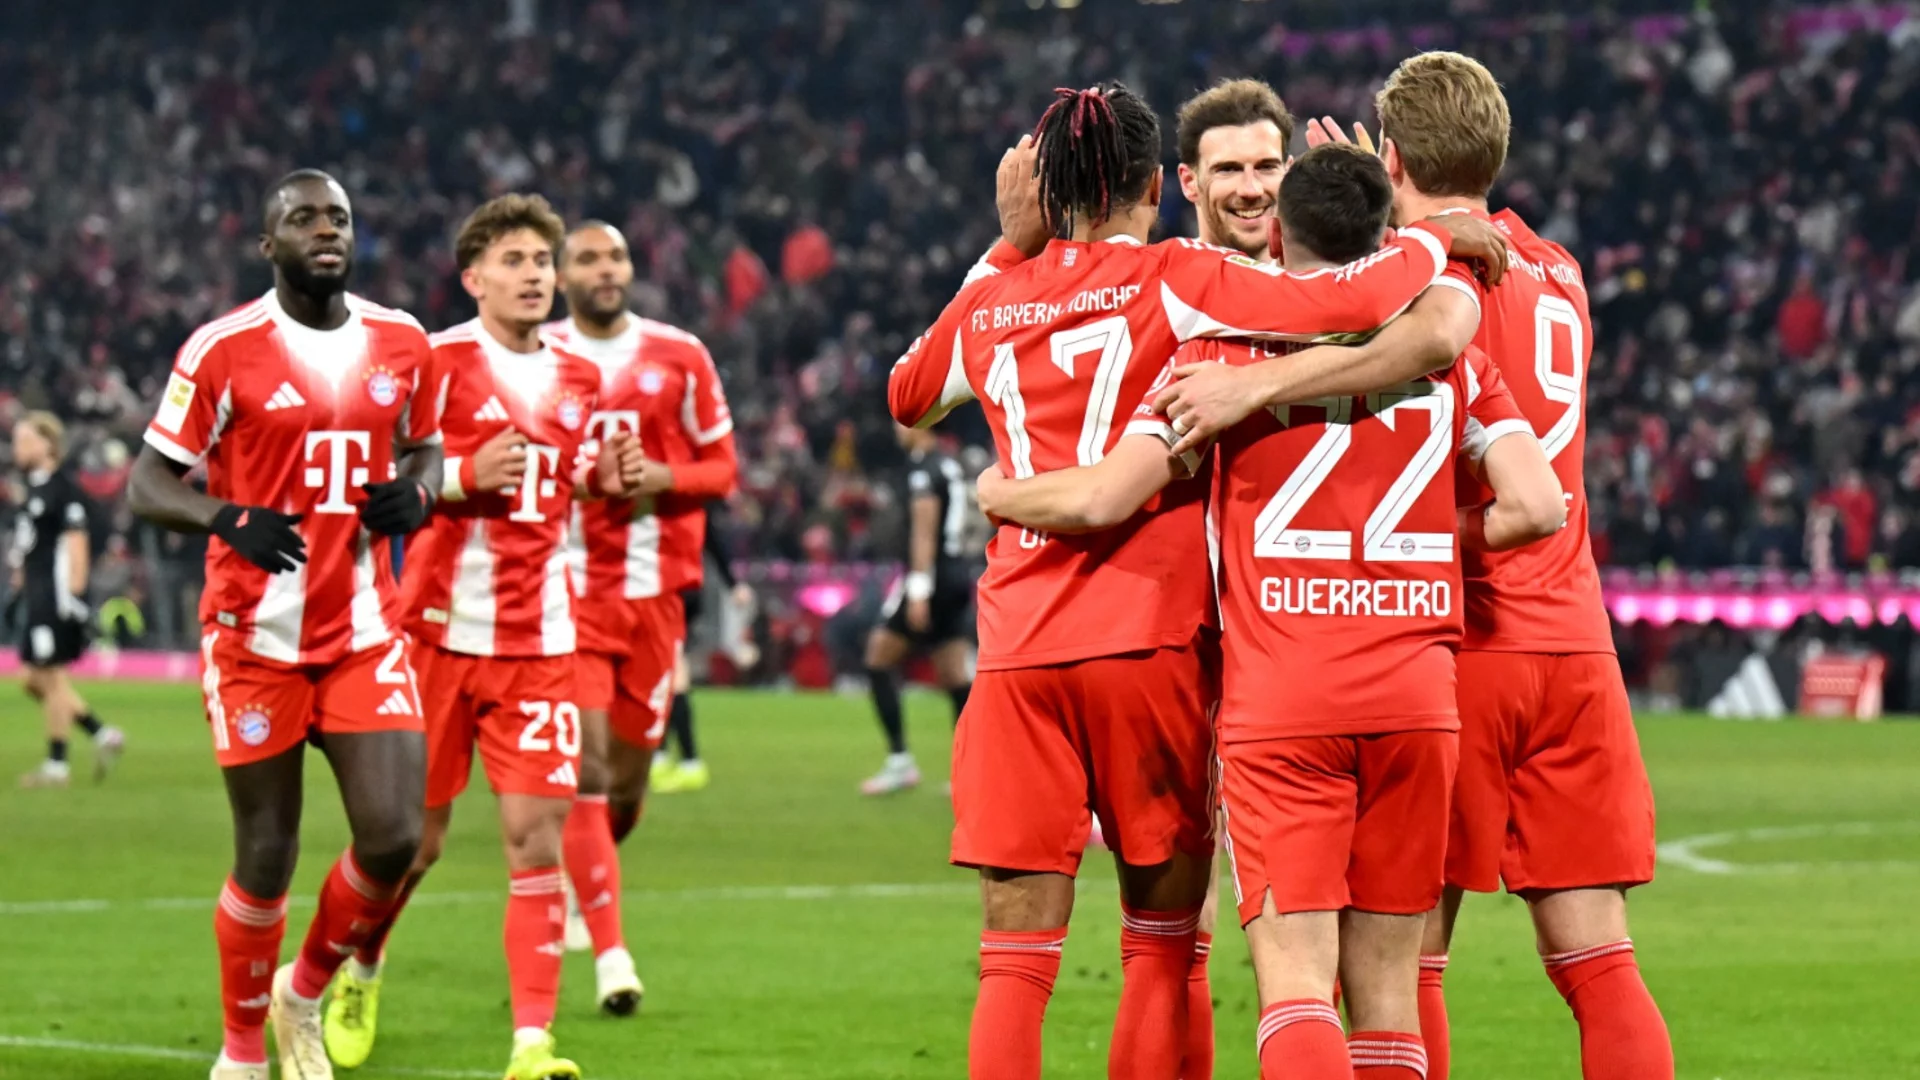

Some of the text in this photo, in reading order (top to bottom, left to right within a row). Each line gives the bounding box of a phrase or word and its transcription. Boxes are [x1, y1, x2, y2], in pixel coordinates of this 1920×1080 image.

[972, 309, 988, 332] FC
[993, 303, 1060, 329] BAYERN
[984, 315, 1133, 479] 17
[1534, 294, 1583, 464] 9
[1254, 381, 1454, 562] 22
[1260, 576, 1451, 617] GUERREIRO
[518, 700, 581, 757] 20
